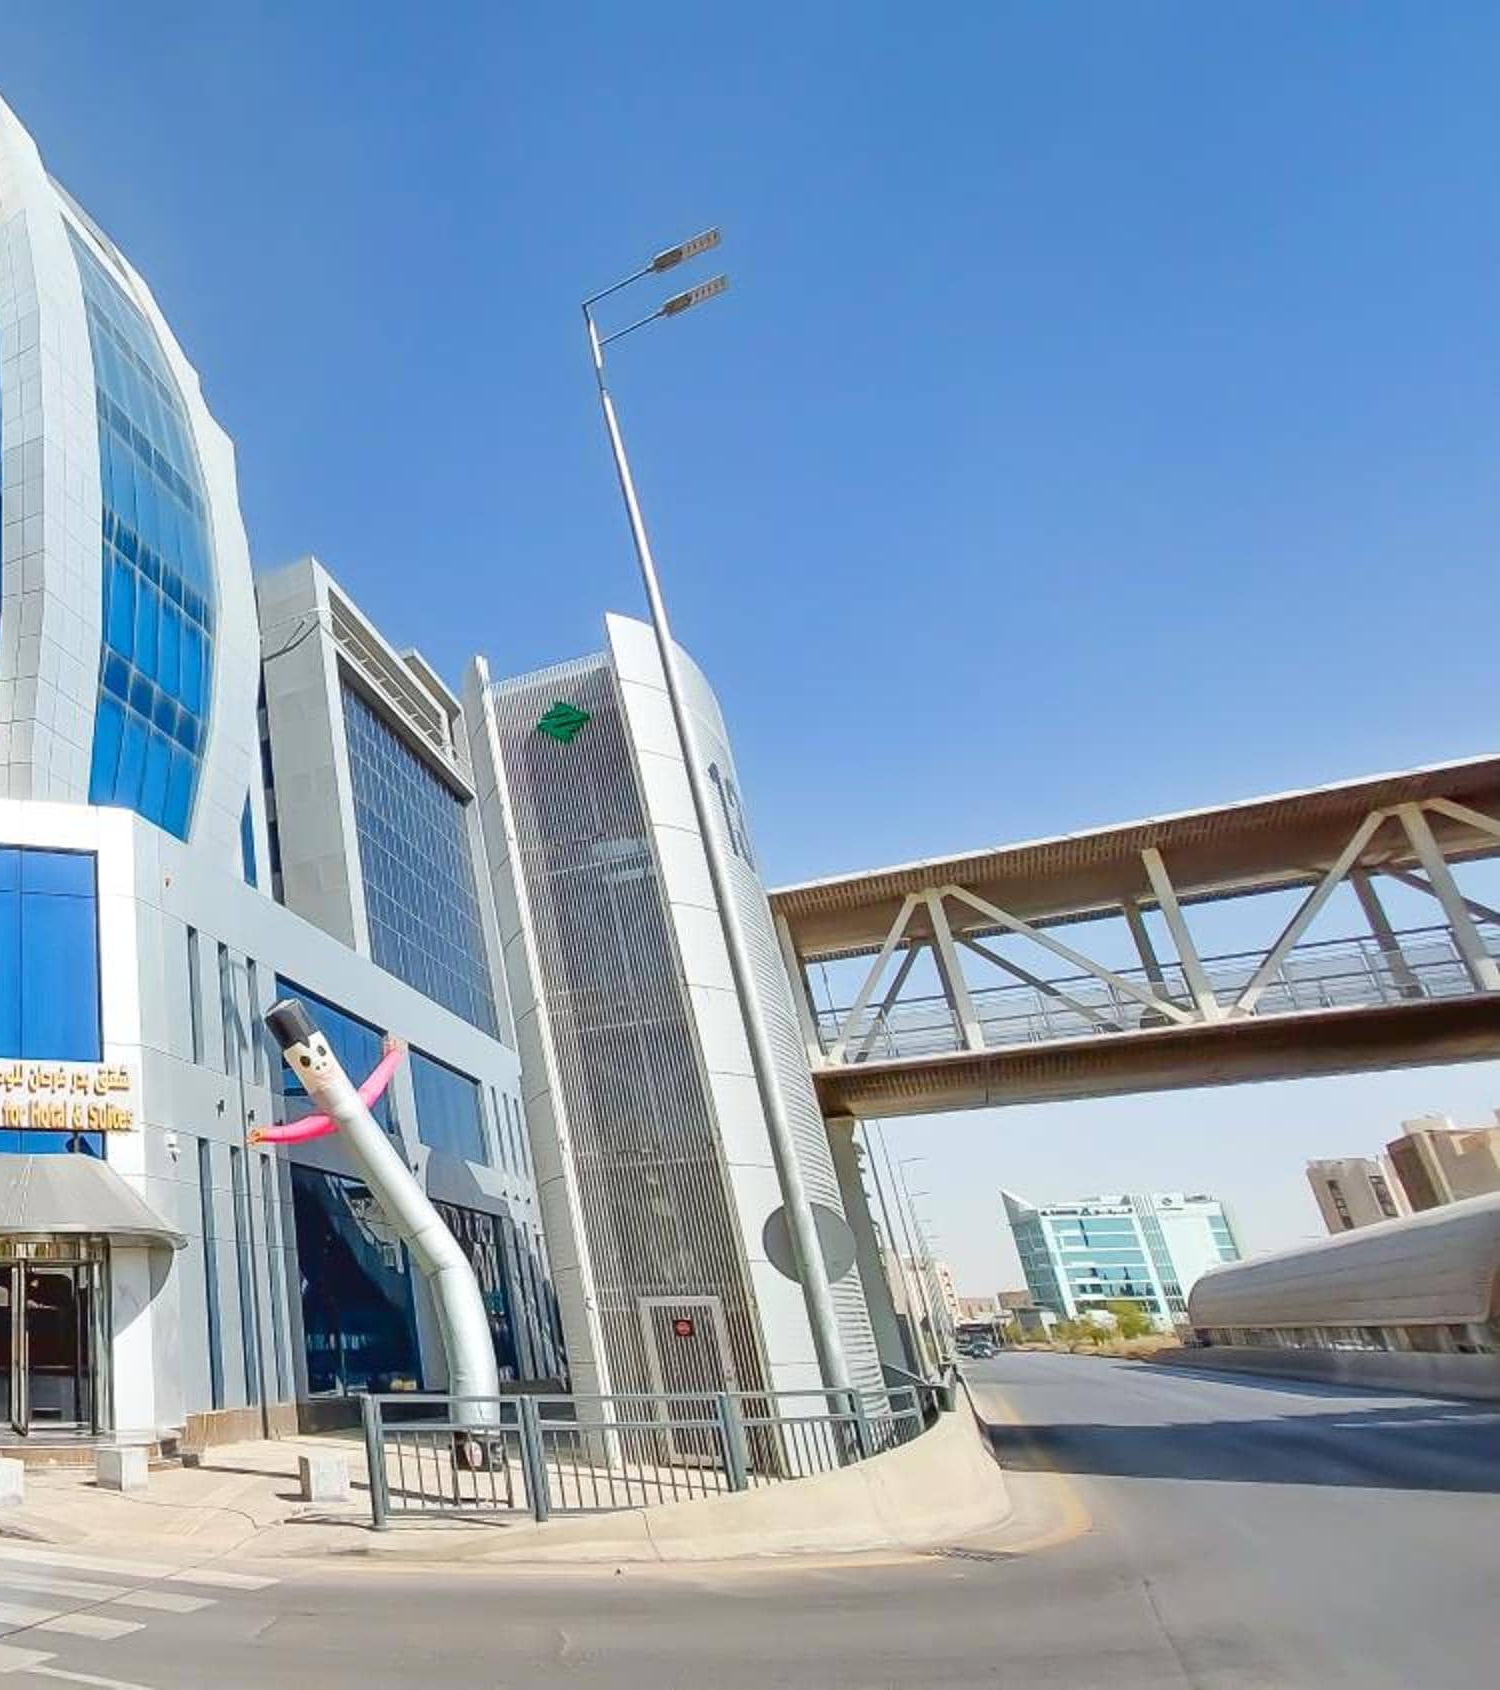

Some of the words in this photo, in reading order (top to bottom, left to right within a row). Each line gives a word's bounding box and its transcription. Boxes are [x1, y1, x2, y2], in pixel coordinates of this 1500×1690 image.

[2, 1100, 28, 1129] for
[71, 1103, 83, 1130] &
[87, 1103, 133, 1131] Suites
